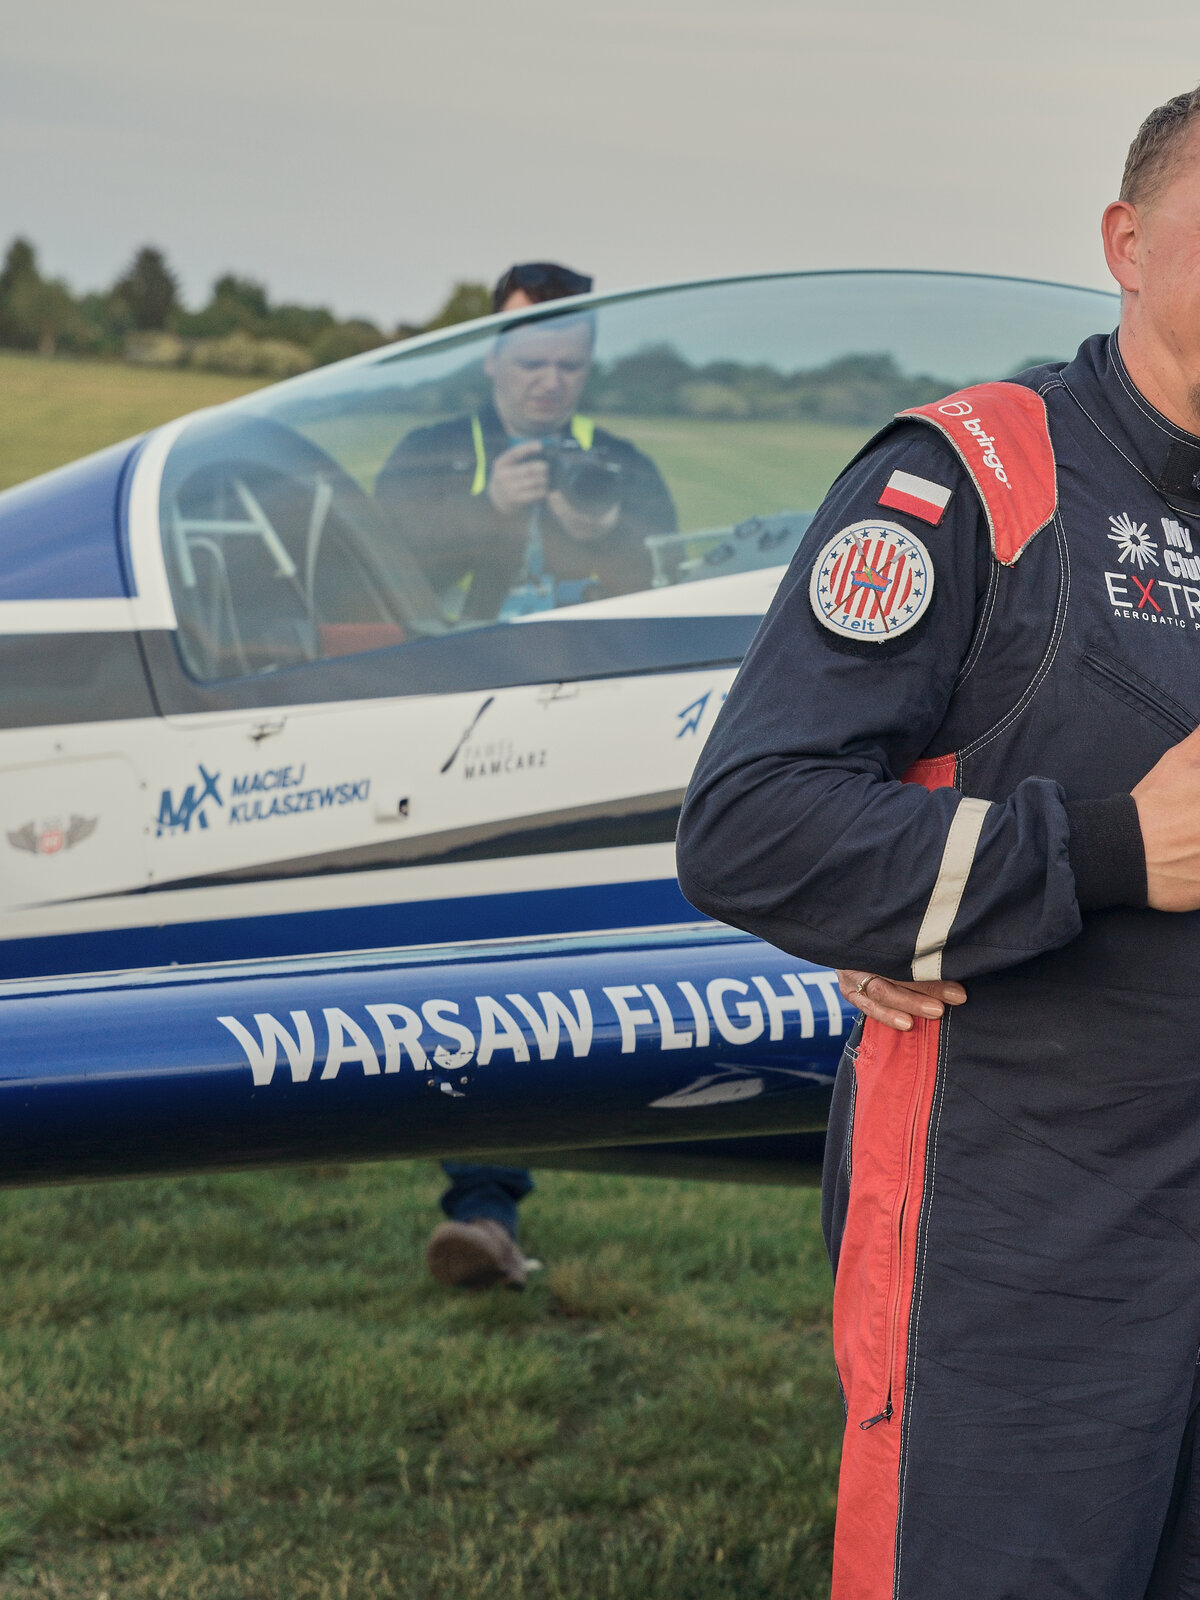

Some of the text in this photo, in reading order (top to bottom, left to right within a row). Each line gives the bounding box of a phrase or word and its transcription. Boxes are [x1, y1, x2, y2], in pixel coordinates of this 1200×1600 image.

[962, 418, 1004, 483] bringo
[1161, 517, 1193, 553] My
[1114, 609, 1186, 628] AEROBATIC
[231, 763, 306, 796] MACIEJ
[216, 971, 843, 1086] WARSAW FLIGHT
